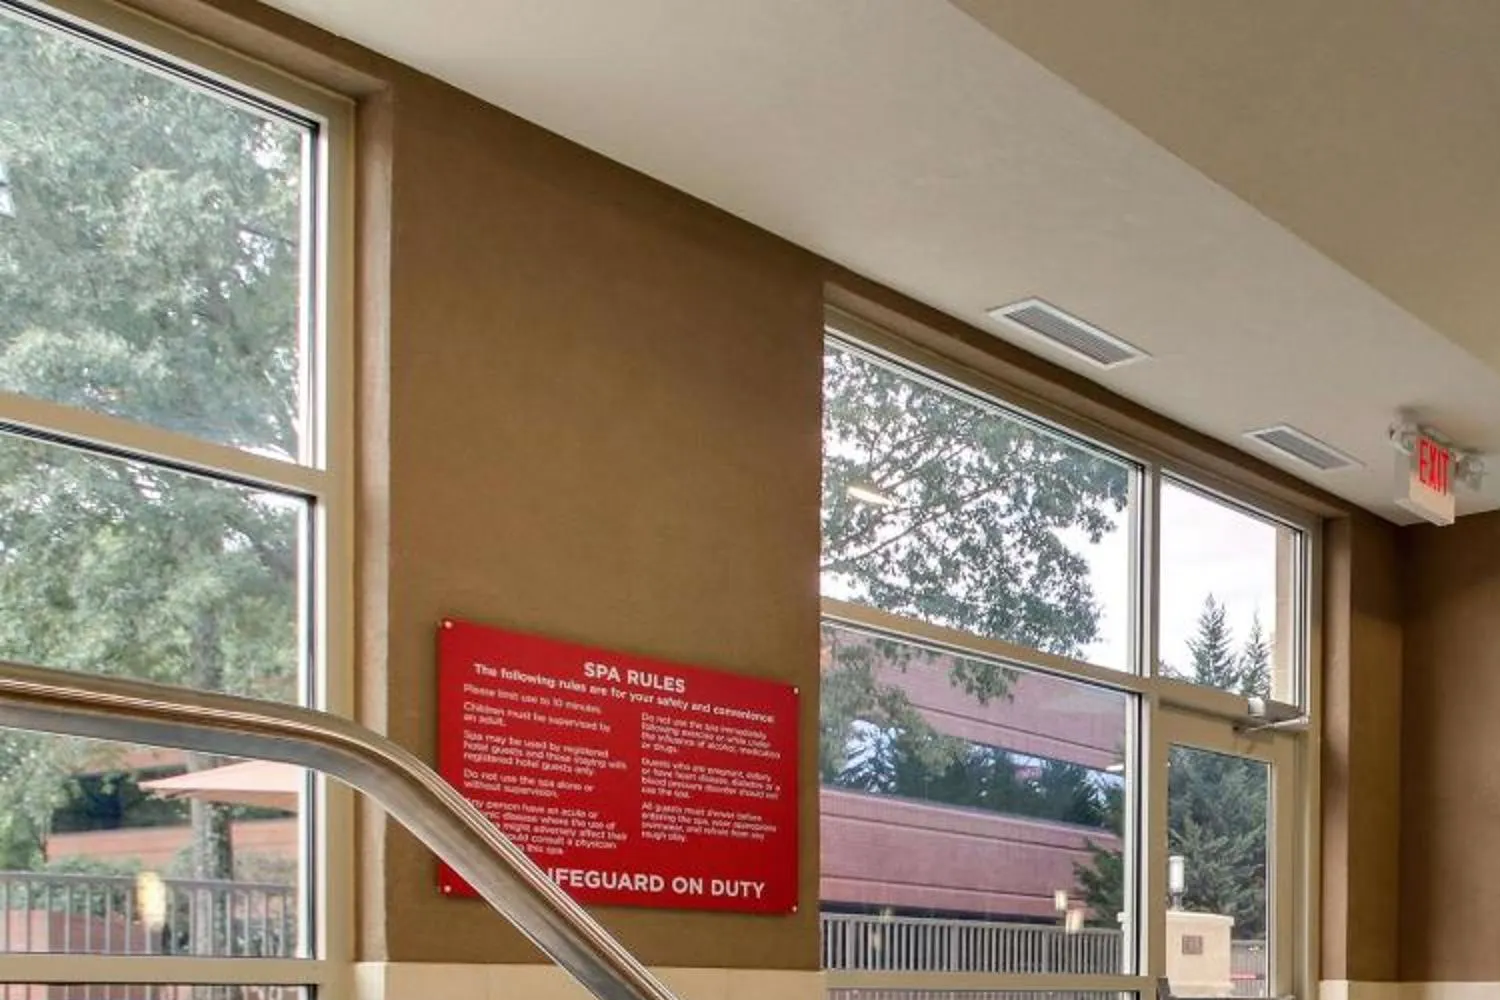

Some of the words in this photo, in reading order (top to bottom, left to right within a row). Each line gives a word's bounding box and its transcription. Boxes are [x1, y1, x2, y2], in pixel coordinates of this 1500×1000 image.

[1420, 440, 1449, 496] EXIT
[473, 663, 497, 678] The
[500, 668, 555, 688] following
[559, 678, 586, 693] rules
[589, 683, 607, 696] are
[611, 687, 627, 700] for
[629, 690, 654, 704] your
[657, 695, 688, 710] safety
[691, 701, 710, 713] and
[583, 662, 620, 683] SPA
[627, 670, 685, 694] RULES
[463, 731, 482, 742] Spa
[485, 734, 506, 745] may
[509, 737, 521, 747] be
[524, 739, 546, 750] used
[549, 742, 560, 752] by
[563, 744, 608, 758] registered
[463, 769, 478, 780] Do
[481, 771, 497, 782] not
[500, 773, 517, 784] use
[519, 775, 536, 786] the
[537, 777, 554, 788] spa
[556, 779, 582, 791] alone
[584, 782, 594, 792] or
[470, 800, 484, 810] ny
[486, 801, 520, 813] person
[507, 833, 529, 843] ould
[547, 867, 665, 892] IFEGUARD
[672, 877, 703, 895] ON
[711, 879, 765, 898] DUTY
